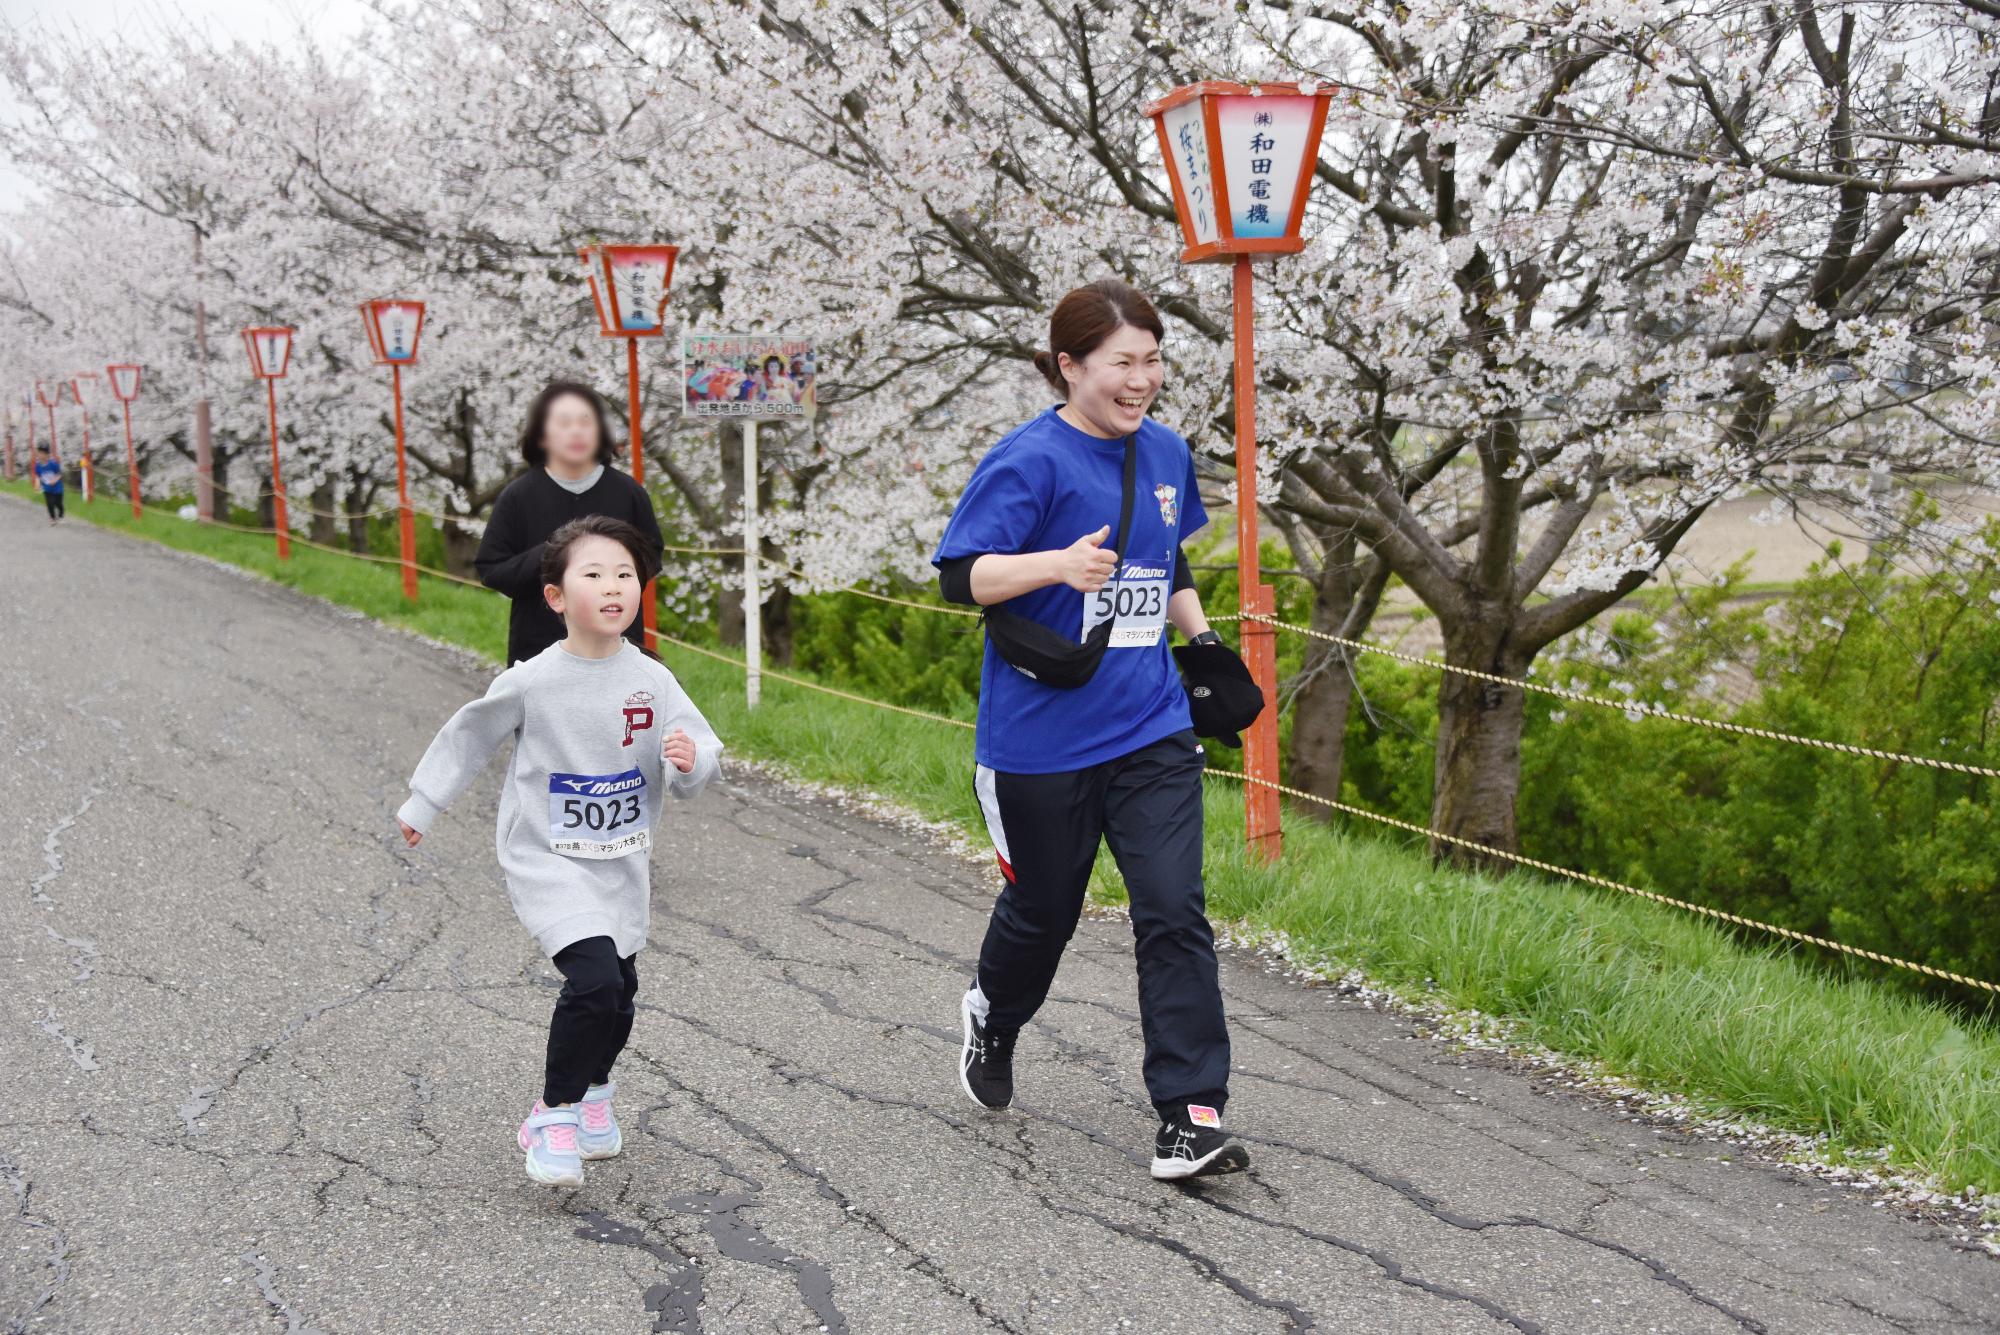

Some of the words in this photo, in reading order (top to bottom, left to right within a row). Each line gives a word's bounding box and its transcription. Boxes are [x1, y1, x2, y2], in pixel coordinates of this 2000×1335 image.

[1095, 586, 1161, 617] 5023
[622, 707, 655, 748] P
[563, 794, 641, 831] 5023
